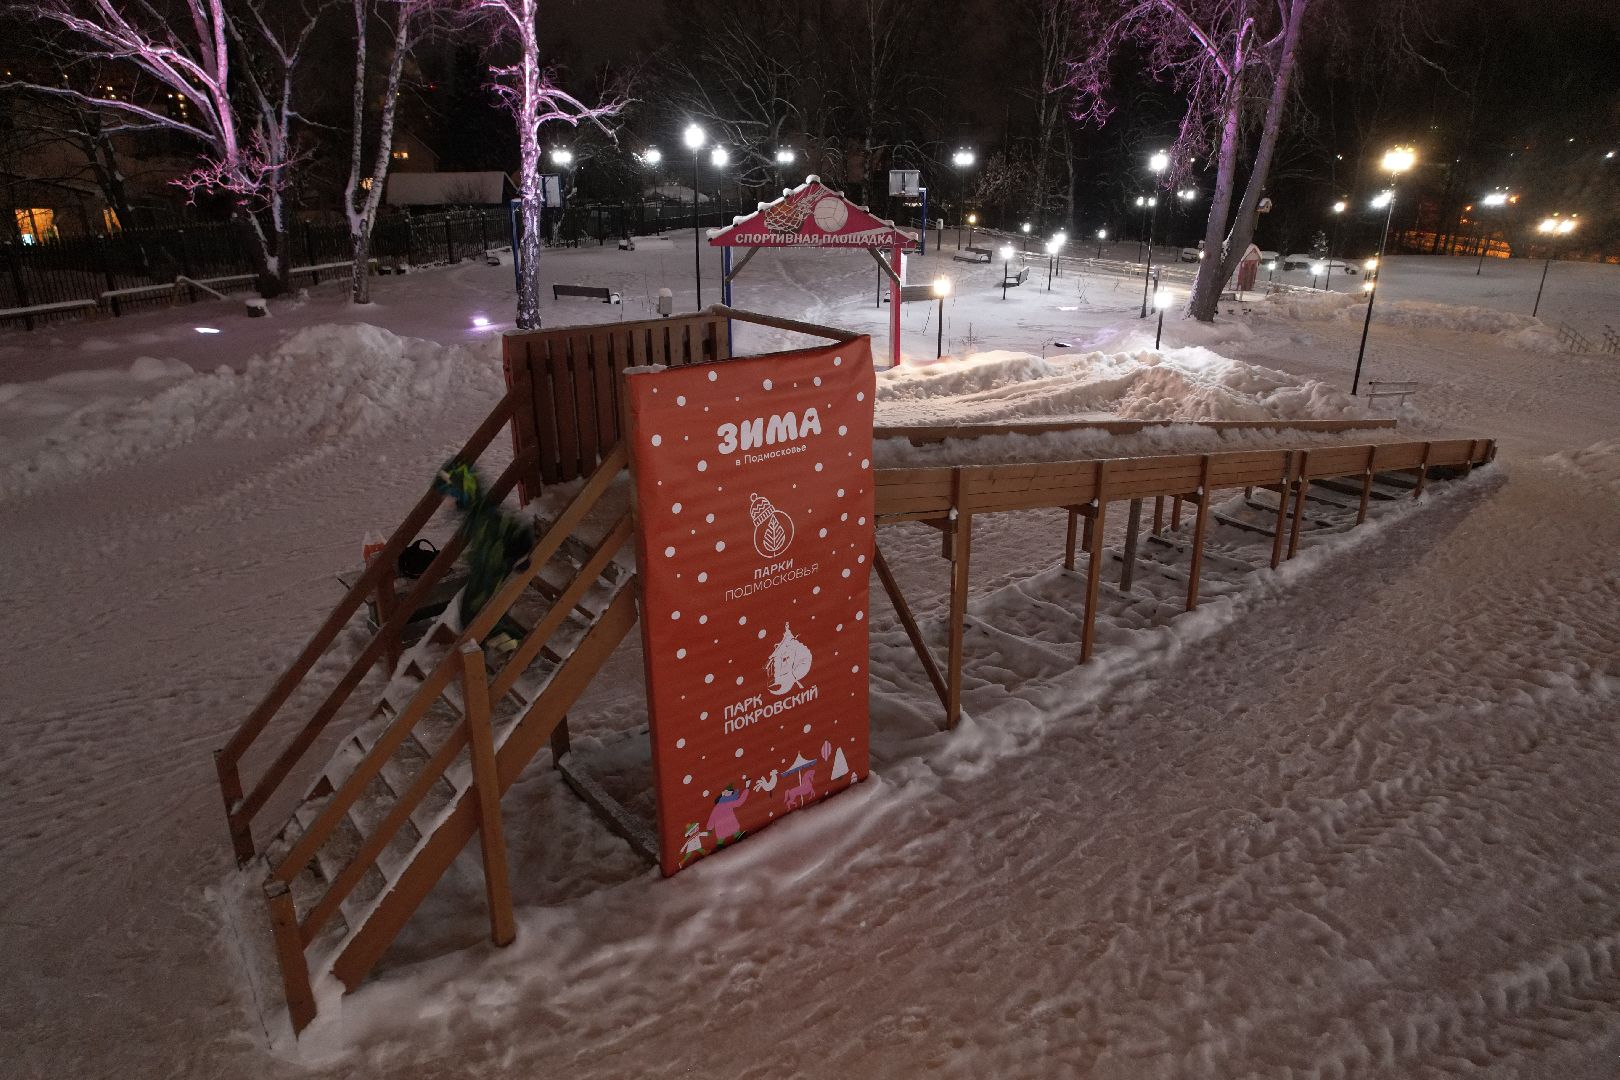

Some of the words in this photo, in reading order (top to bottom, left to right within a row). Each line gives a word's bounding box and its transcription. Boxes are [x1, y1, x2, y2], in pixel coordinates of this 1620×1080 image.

[735, 233, 819, 245] СПОРТИВНАЯ
[822, 233, 894, 247] ПЛОЩАДКА
[716, 407, 822, 455] ЗИМА
[744, 444, 807, 465] Подмосковье
[725, 563, 819, 601] ПОДМОСКОВЬЯ
[754, 558, 794, 580] ПАРКИ
[724, 693, 763, 720] ПАРК
[724, 685, 819, 735] ПОКРОВСКИЙ
